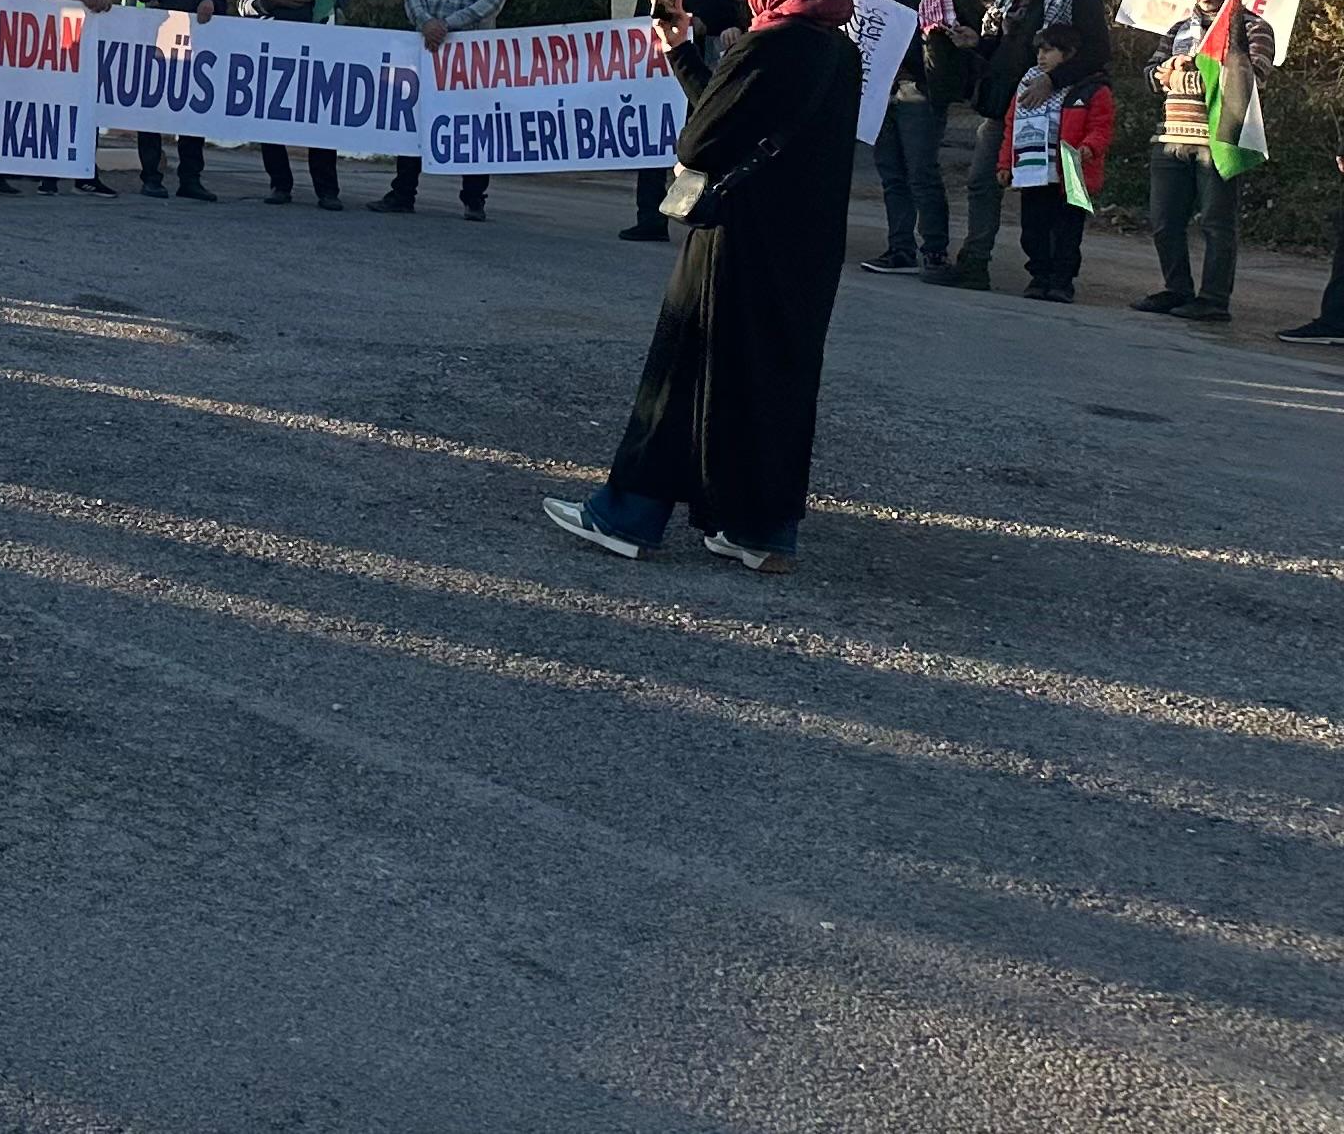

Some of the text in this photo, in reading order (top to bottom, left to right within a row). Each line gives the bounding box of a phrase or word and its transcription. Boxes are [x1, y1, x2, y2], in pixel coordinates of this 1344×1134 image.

[96, 33, 421, 133] KUDÜS BİZİMDİR
[431, 34, 579, 92] VANALARI
[430, 98, 569, 164] GEMİLERİ
